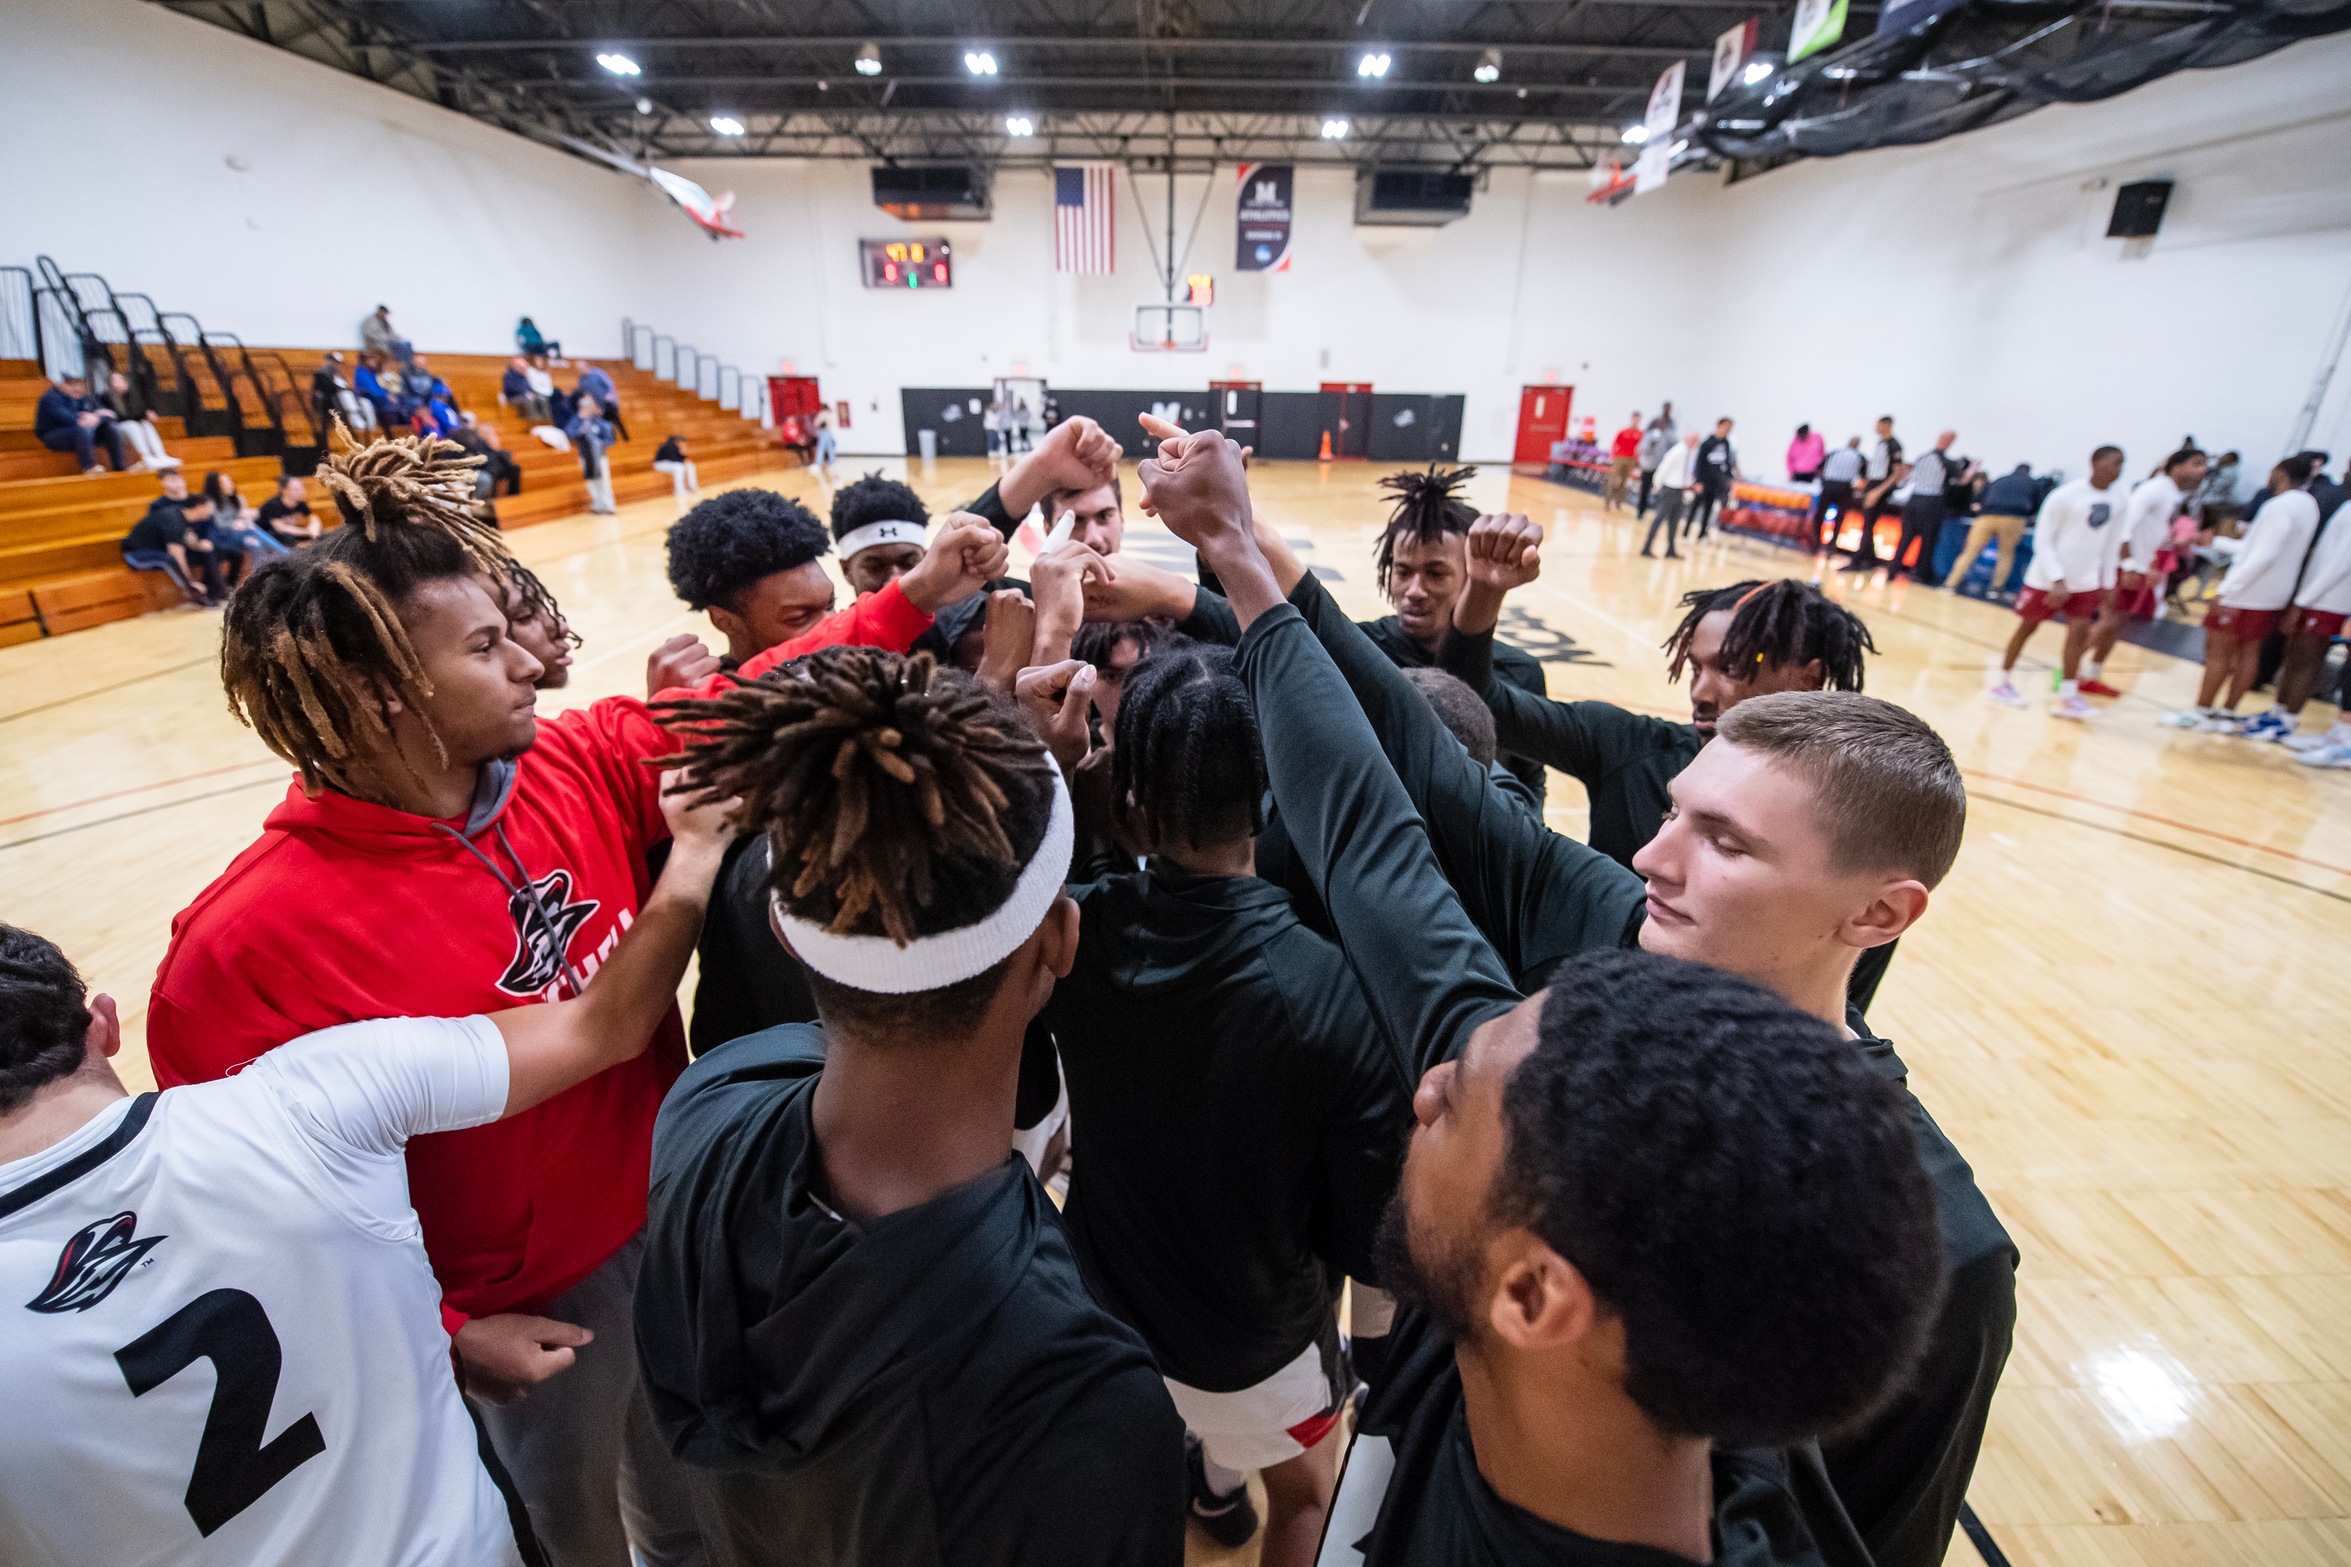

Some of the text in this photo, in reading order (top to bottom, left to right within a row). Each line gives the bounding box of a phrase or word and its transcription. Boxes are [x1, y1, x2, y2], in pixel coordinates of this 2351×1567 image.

[1255, 181, 1277, 203] M
[141, 1258, 155, 1268] TM
[113, 1288, 327, 1539] 2
